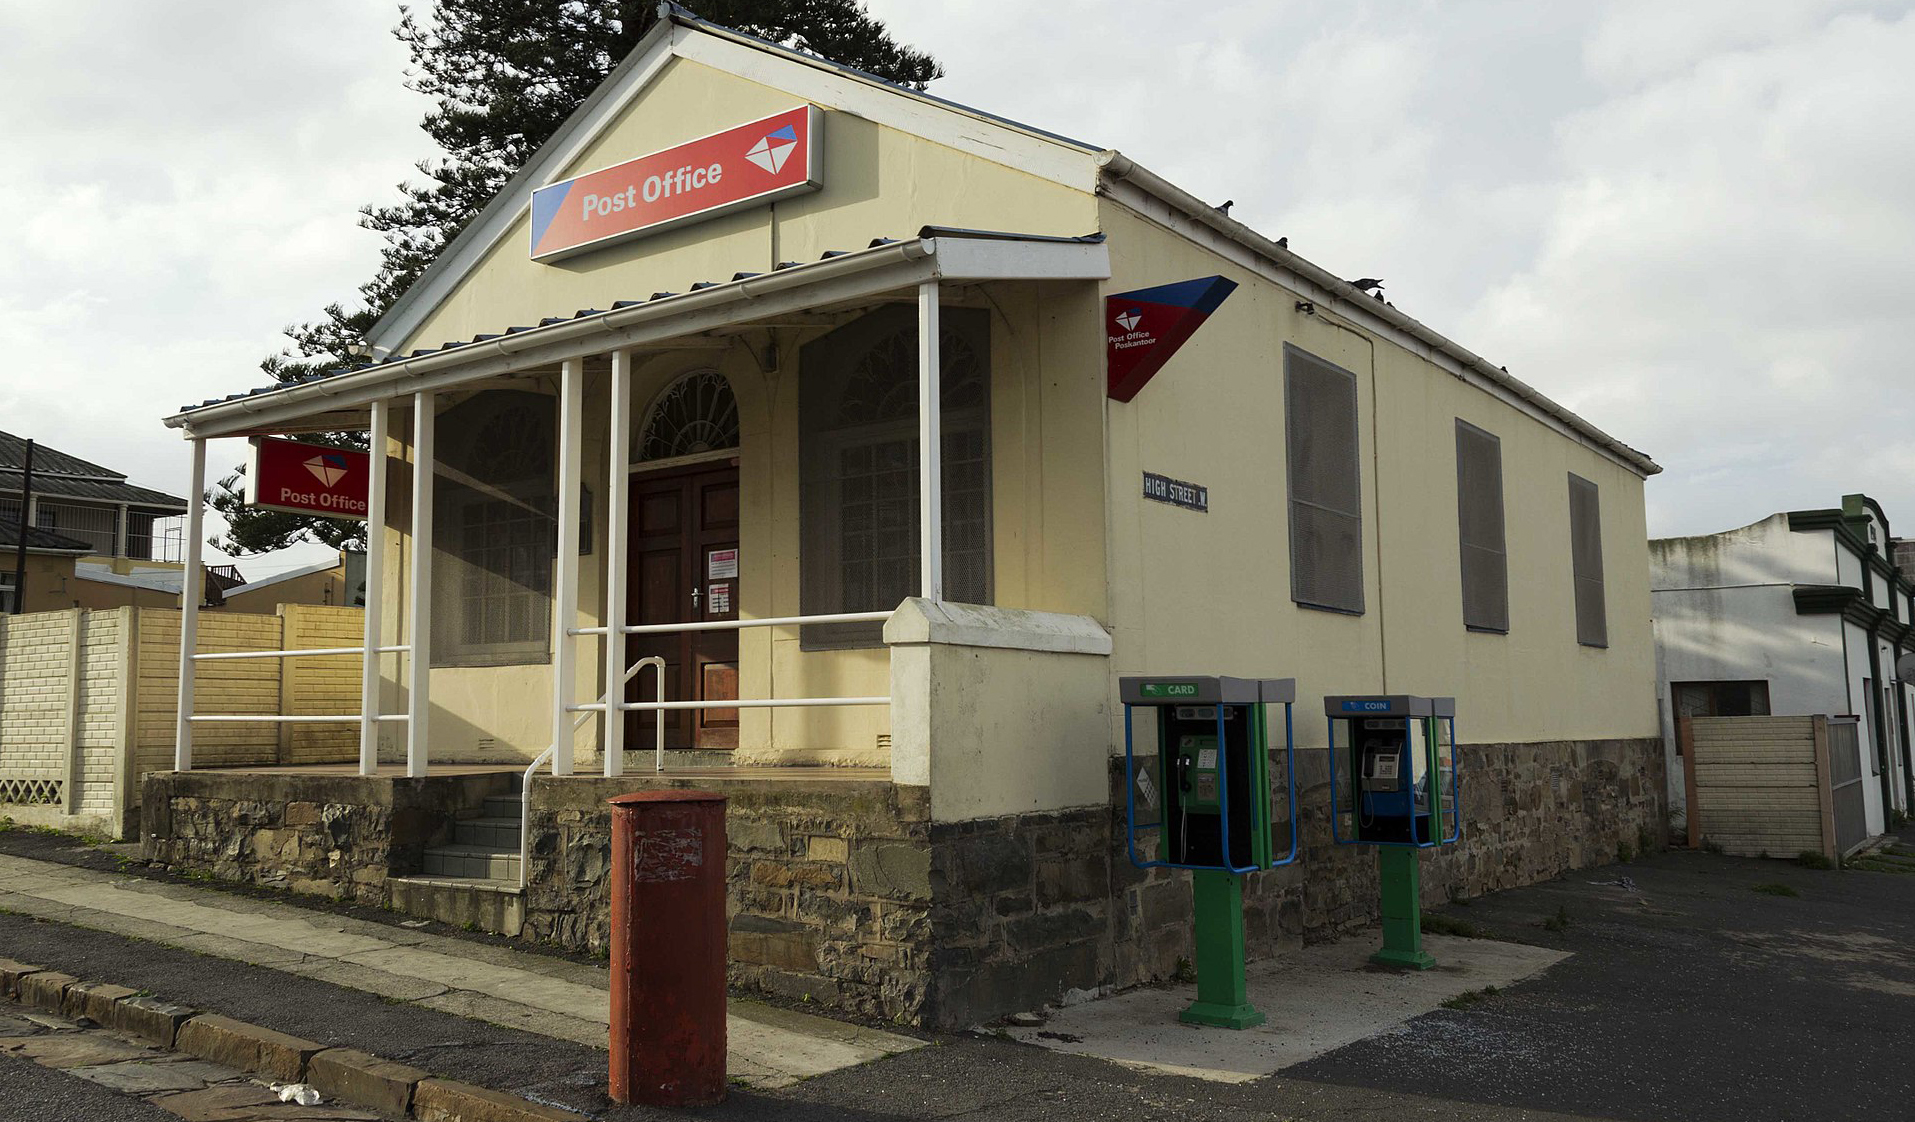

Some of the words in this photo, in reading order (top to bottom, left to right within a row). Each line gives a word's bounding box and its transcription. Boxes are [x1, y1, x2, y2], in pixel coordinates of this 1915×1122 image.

[582, 185, 636, 221] Post
[642, 163, 722, 203] Office
[1108, 335, 1125, 343] Post
[1126, 331, 1150, 340] Office
[1115, 338, 1156, 349] Poskantoor
[1145, 477, 1166, 497] HIGH
[1169, 483, 1197, 504] STREET
[281, 487, 316, 505] Post
[319, 493, 366, 511] Office
[1167, 685, 1195, 695] CARD
[1364, 702, 1387, 710] COIN
